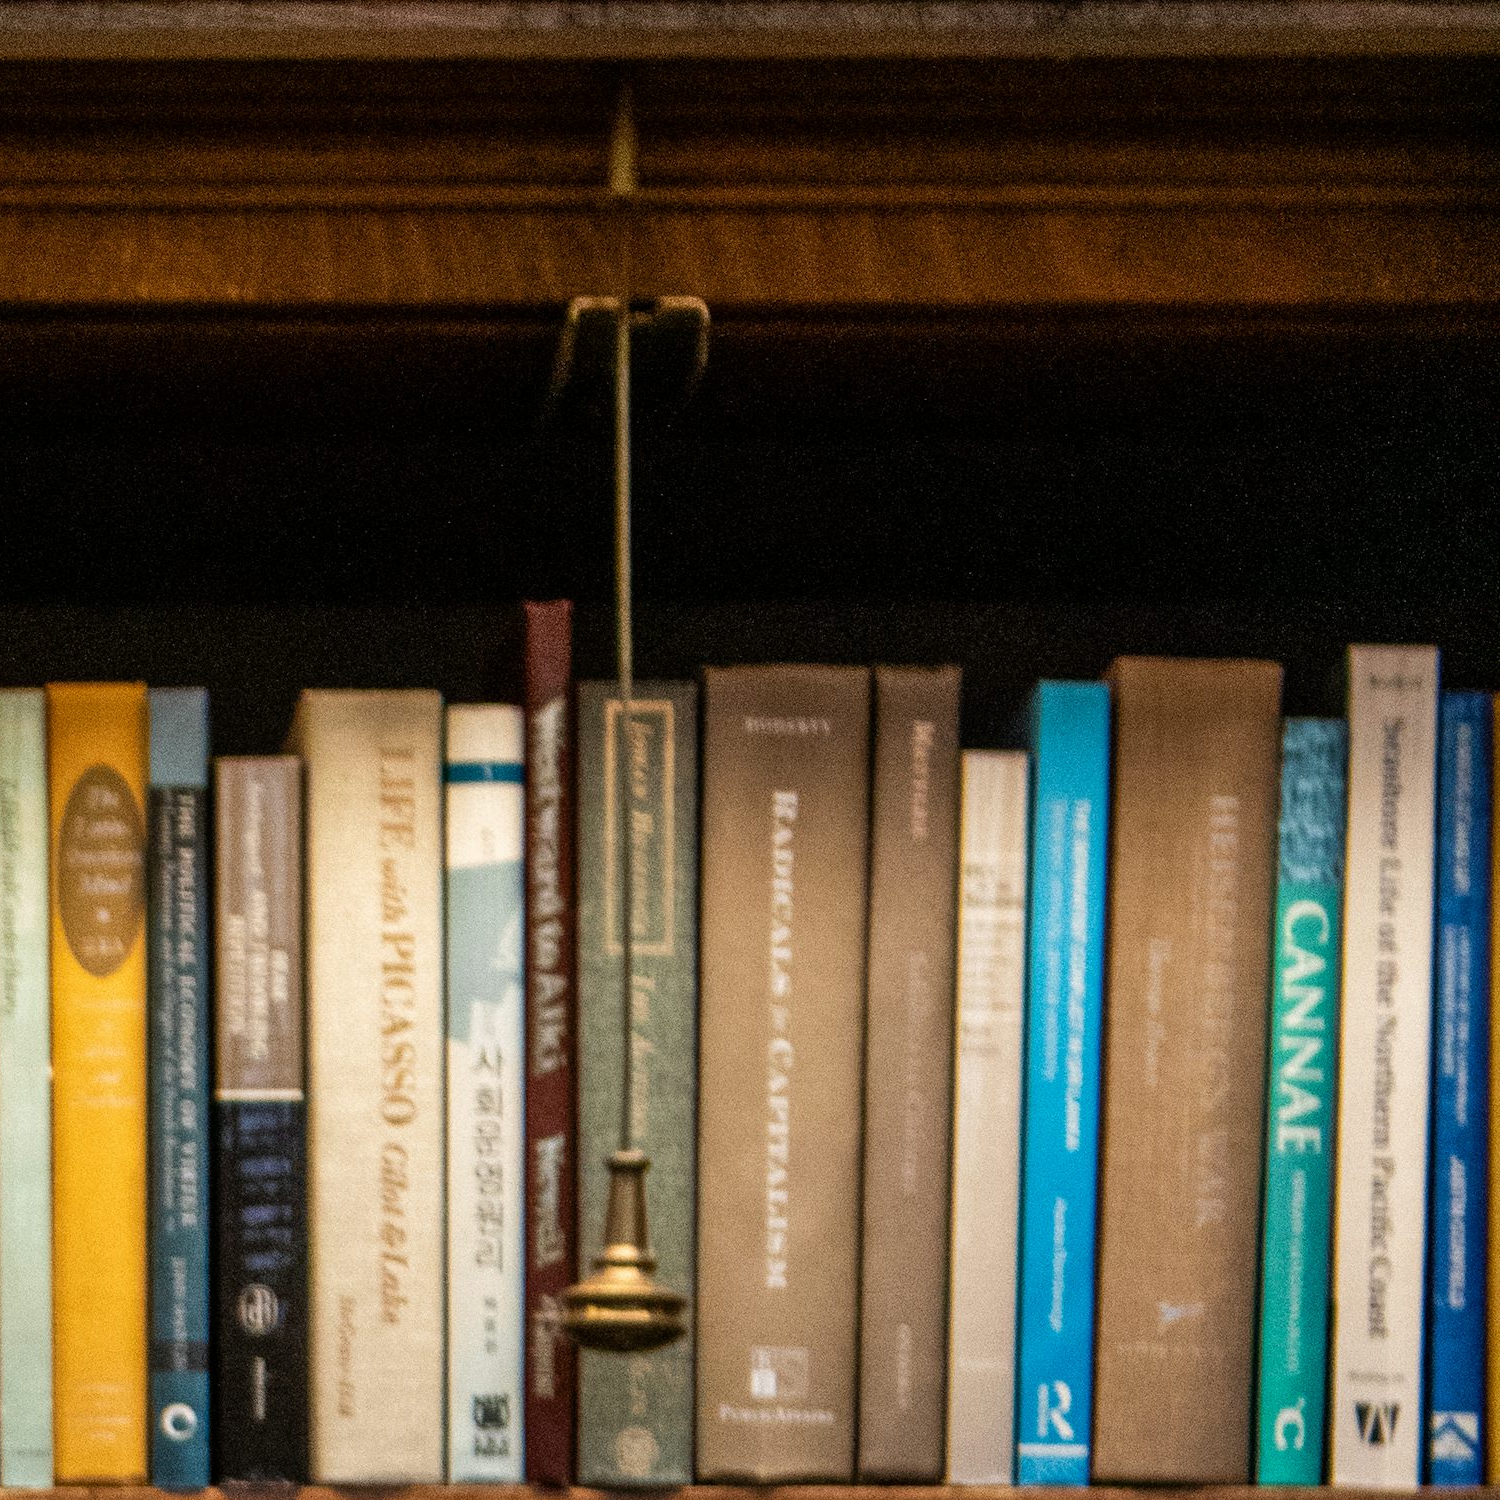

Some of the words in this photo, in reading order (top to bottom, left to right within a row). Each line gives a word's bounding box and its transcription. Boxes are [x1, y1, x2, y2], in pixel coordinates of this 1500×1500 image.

[380, 750, 416, 850] LIFE
[771, 790, 798, 996] RADICALS
[380, 932, 416, 1126] PICASSO
[1277, 899, 1330, 1155] CANNAE
[766, 1037, 794, 1288] CAPITALISM
